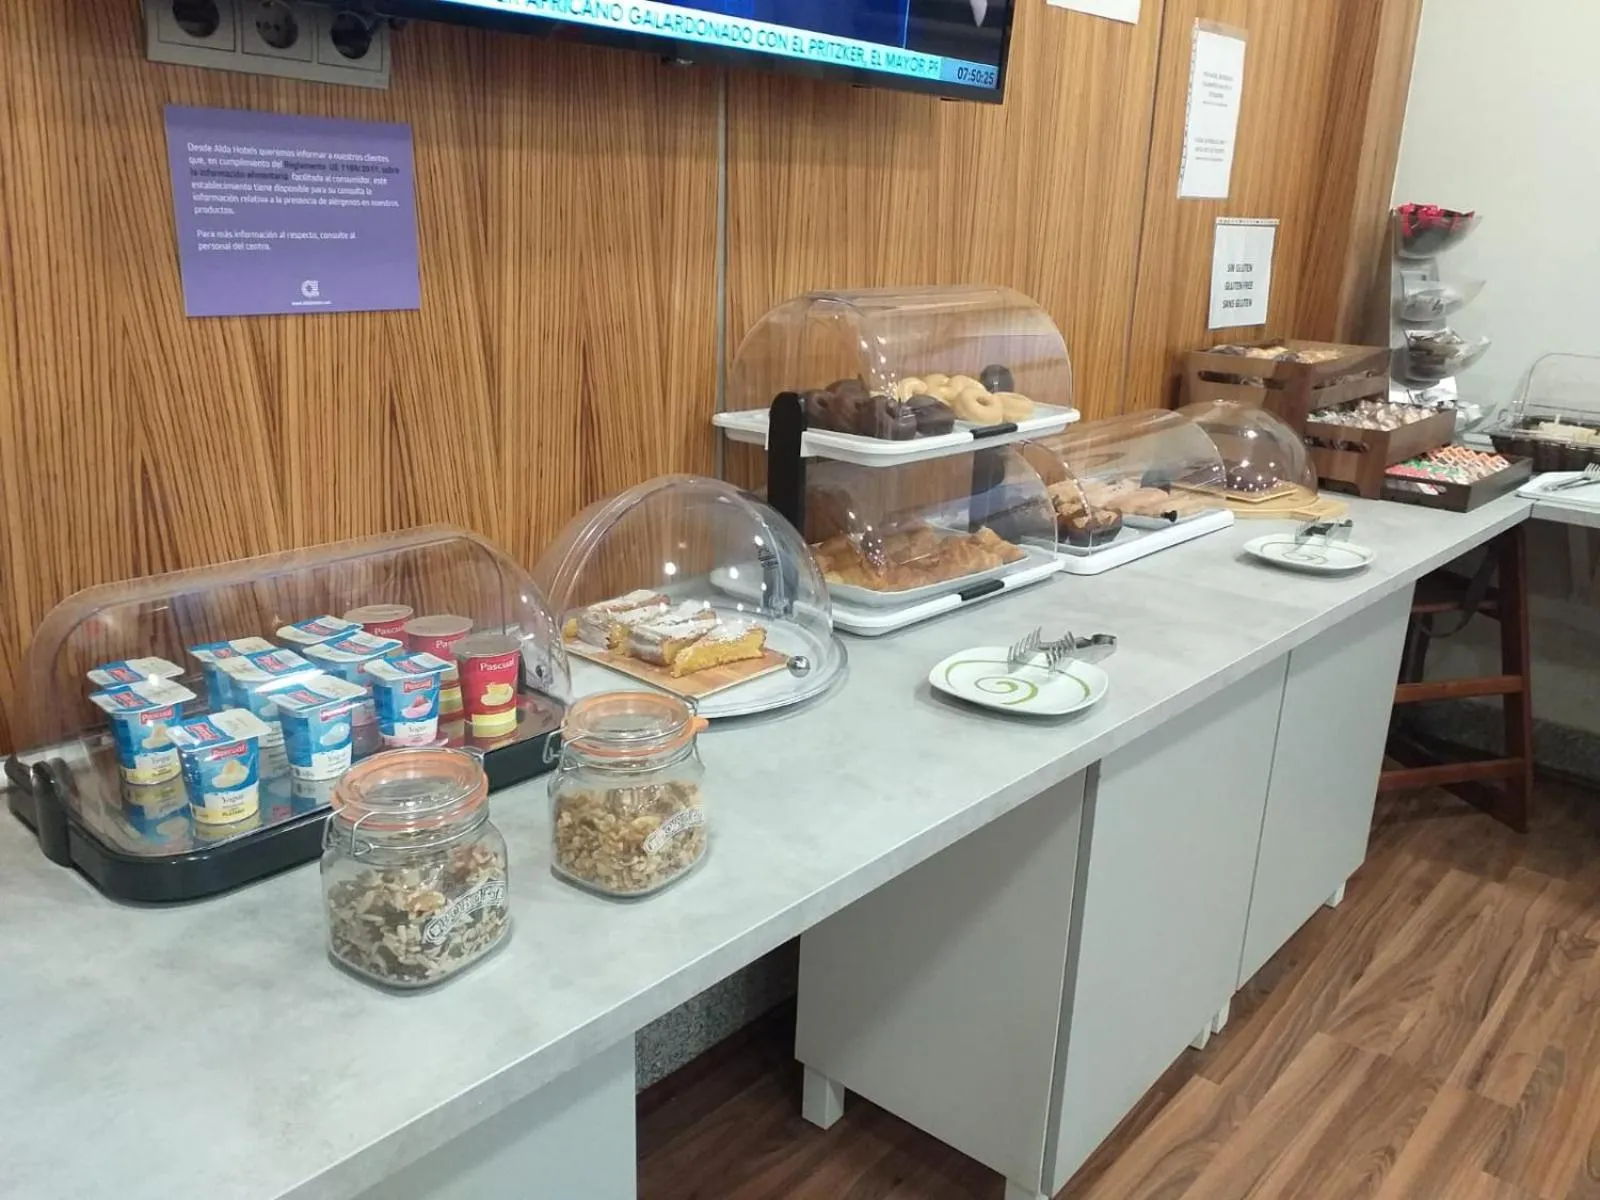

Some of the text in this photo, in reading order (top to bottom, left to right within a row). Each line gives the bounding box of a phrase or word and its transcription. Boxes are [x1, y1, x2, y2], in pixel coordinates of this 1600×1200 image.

[629, 6, 752, 43] GALARDONADO
[757, 30, 788, 49] CON
[792, 35, 804, 53] EL
[809, 38, 865, 66] PRITZKER,
[871, 49, 881, 65] EL
[885, 52, 924, 71] MAYOR
[957, 66, 994, 85] 07:50:25
[187, 142, 212, 152] Desde
[233, 145, 258, 155] Hotels
[259, 147, 295, 157] queremos
[296, 149, 327, 160] informar
[328, 152, 333, 160] a
[333, 152, 363, 161] nuestros
[207, 157, 218, 165] en
[219, 157, 271, 168] cumplimiento
[271, 159, 283, 168] del
[253, 183, 273, 192] tiene
[274, 184, 310, 194] disponible
[366, 187, 373, 195] la
[275, 195, 282, 204] la
[318, 197, 327, 205] de
[196, 229, 216, 238] Para
[216, 229, 233, 238] más
[234, 229, 278, 239] información
[279, 230, 286, 239] al
[349, 231, 356, 239] al
[197, 241, 231, 251] personal
[232, 241, 244, 250] del
[1227, 263, 1253, 273] SIN GLUTEN
[1224, 281, 1243, 291] GLUTEN
[1222, 298, 1252, 309] SANS GLUTEN
[479, 658, 516, 671] Pascual
